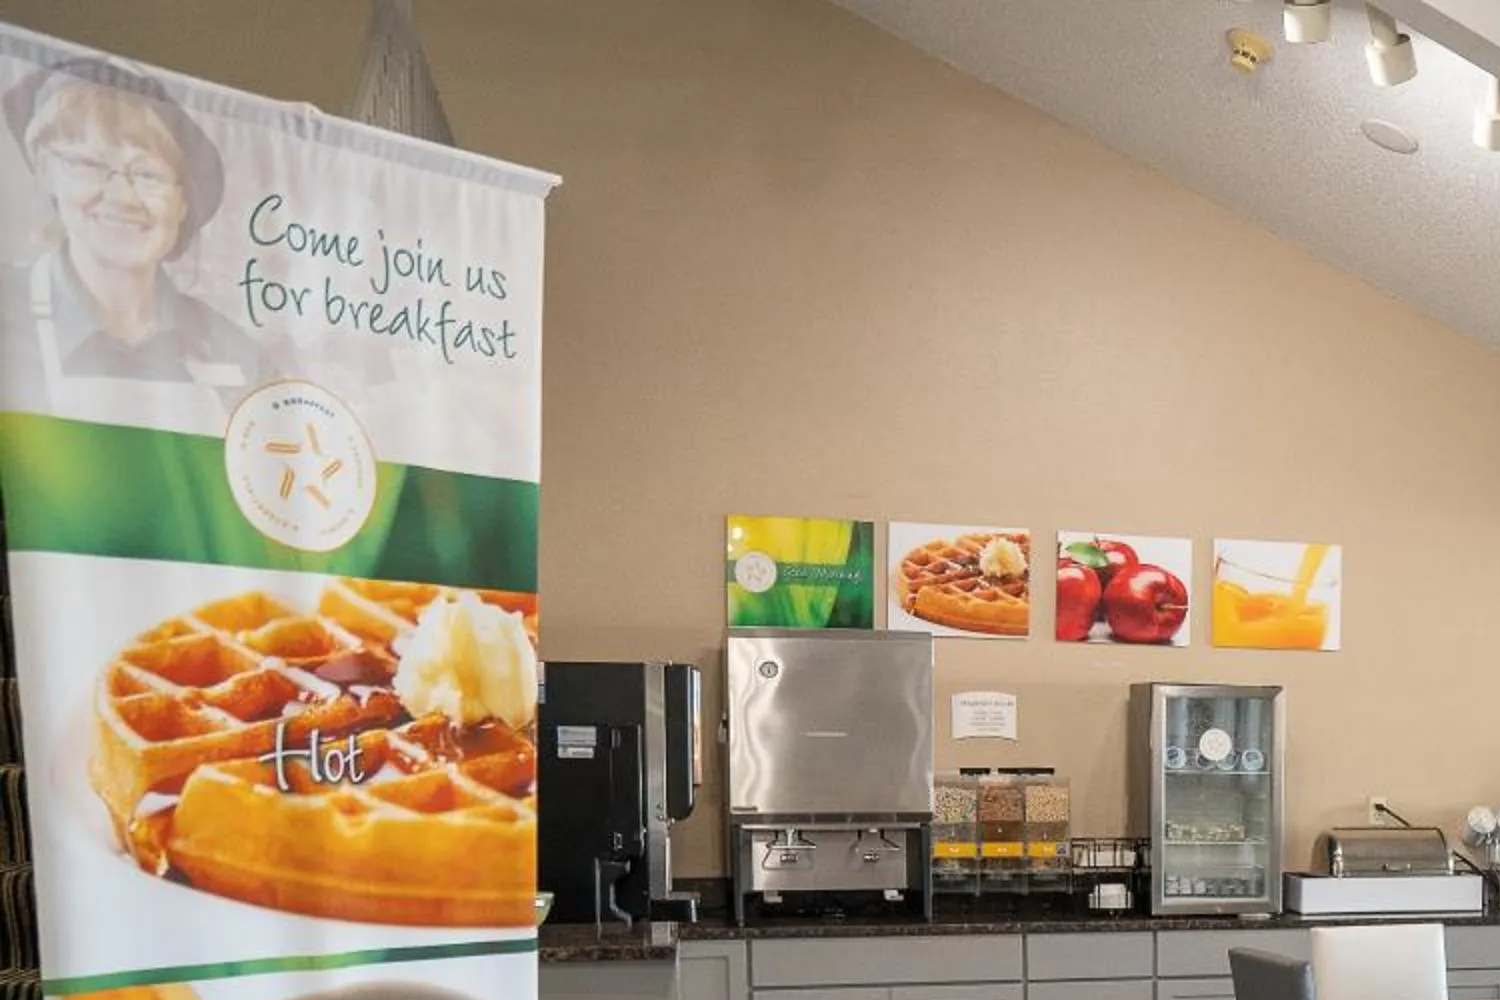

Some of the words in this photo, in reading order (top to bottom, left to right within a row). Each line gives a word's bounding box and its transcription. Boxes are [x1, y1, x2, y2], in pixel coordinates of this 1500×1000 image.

[249, 194, 364, 267] Come
[370, 229, 451, 295] join
[466, 266, 507, 300] us
[239, 258, 311, 328] for
[324, 276, 517, 365] breakfast
[258, 721, 365, 792] Hot
